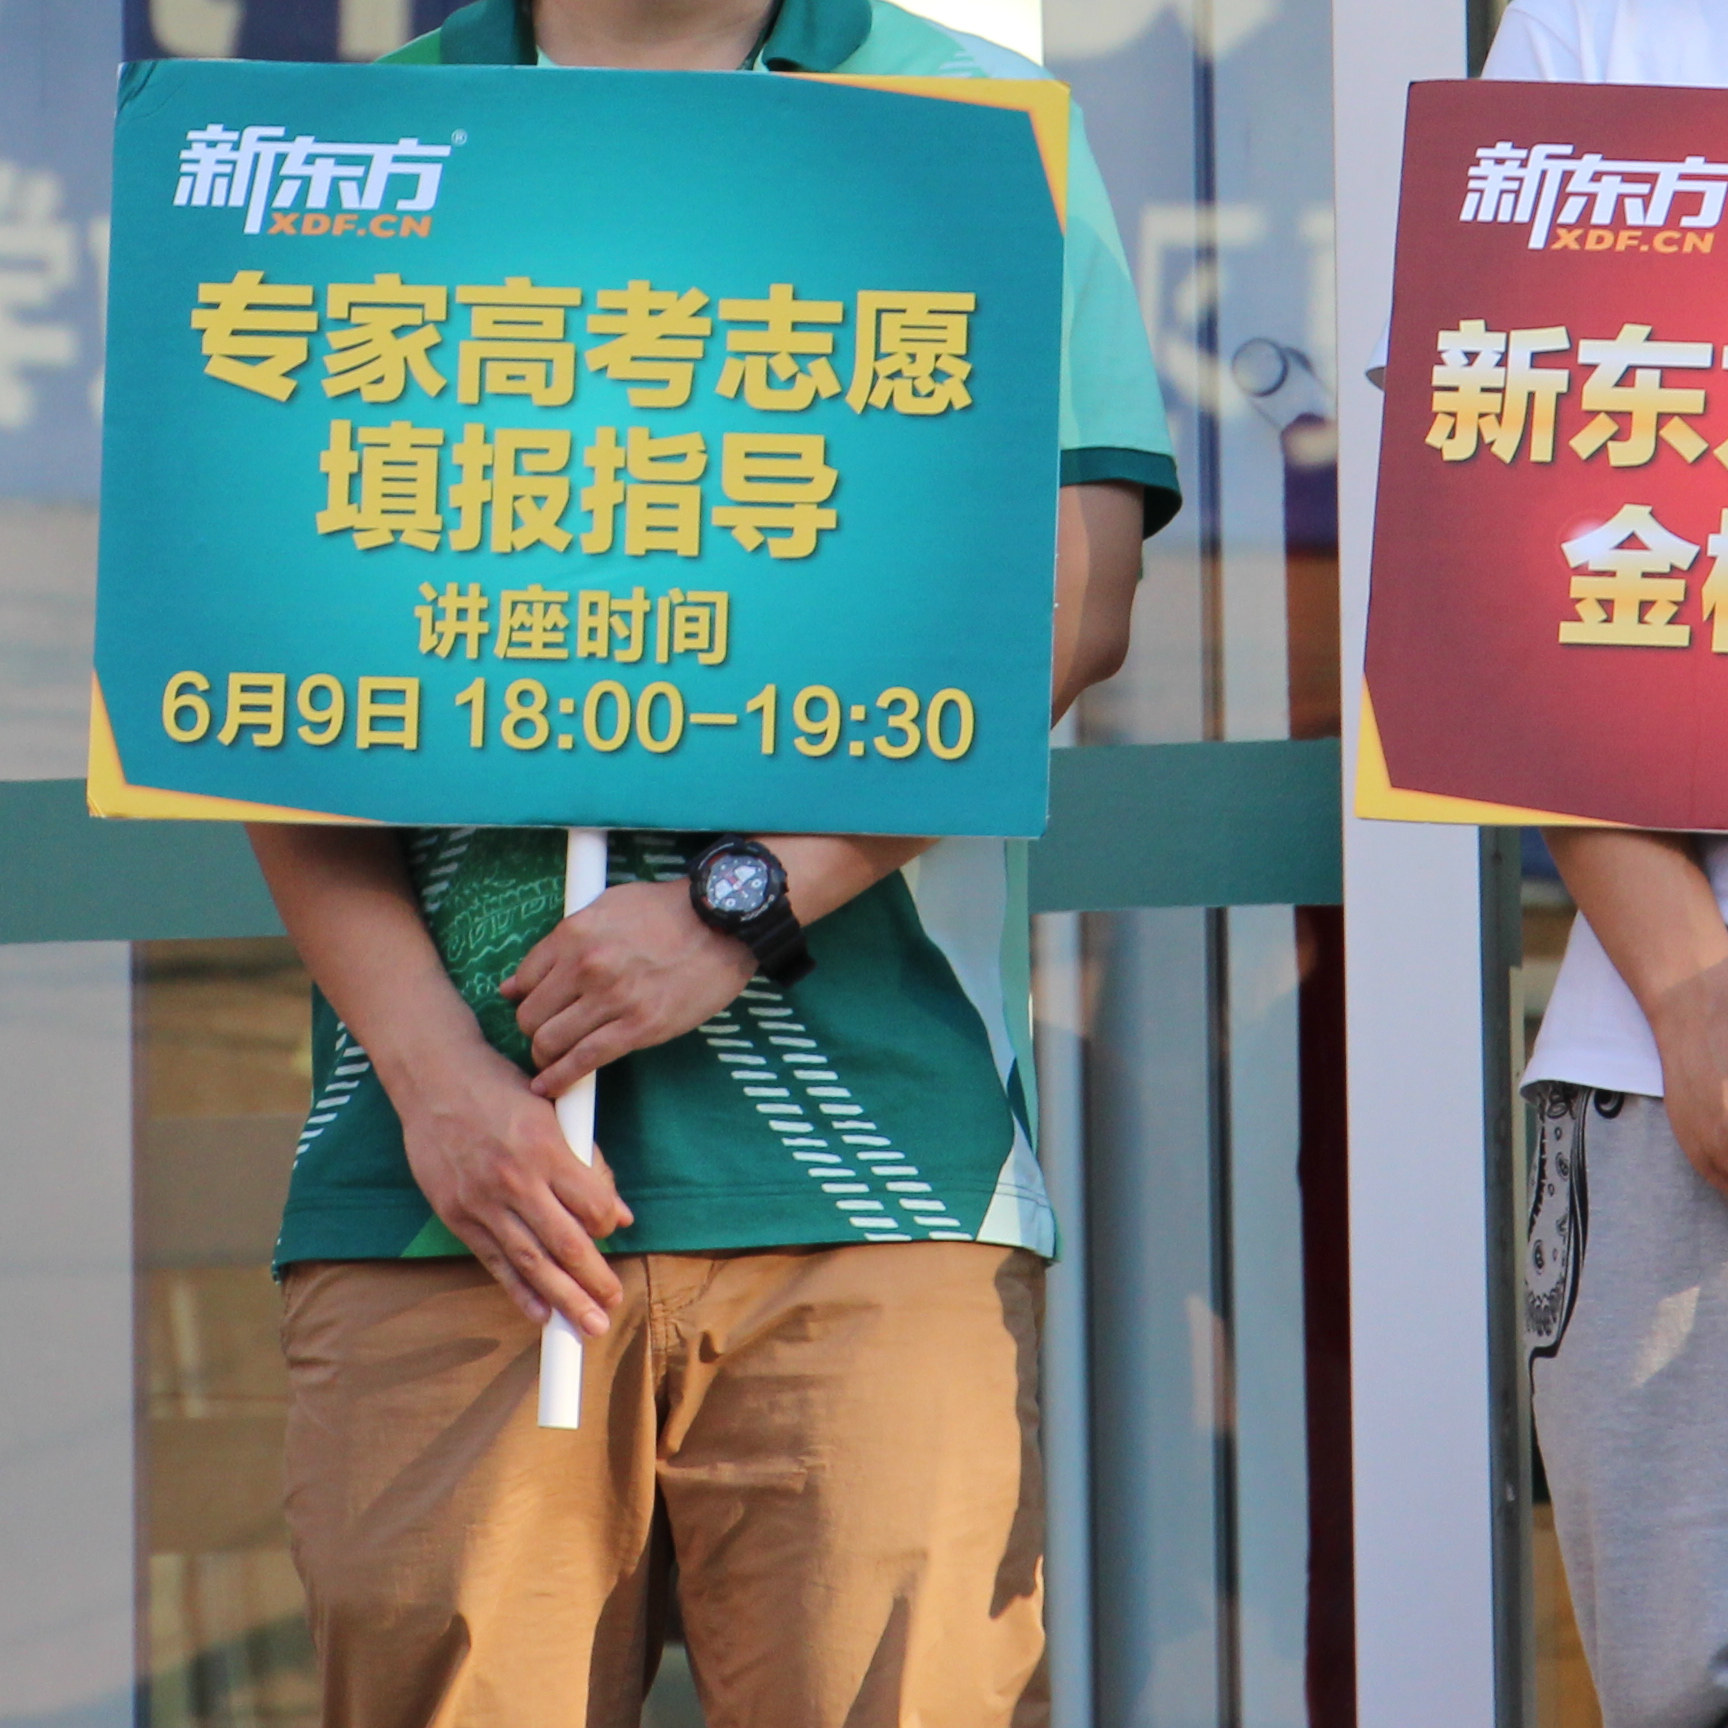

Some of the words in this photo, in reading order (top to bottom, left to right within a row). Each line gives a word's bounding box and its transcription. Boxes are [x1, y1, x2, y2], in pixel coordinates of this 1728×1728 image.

[173, 123, 452, 234] 新东方
[267, 212, 432, 239] XDF.CN
[1550, 227, 1714, 255] XDF.CN
[190, 270, 976, 416] 专家高考志愿
[315, 419, 839, 561] 填报指导
[413, 583, 729, 667] 讲座时间
[161, 671, 422, 751] 6月9日
[454, 677, 976, 761] 18:00-19:30
